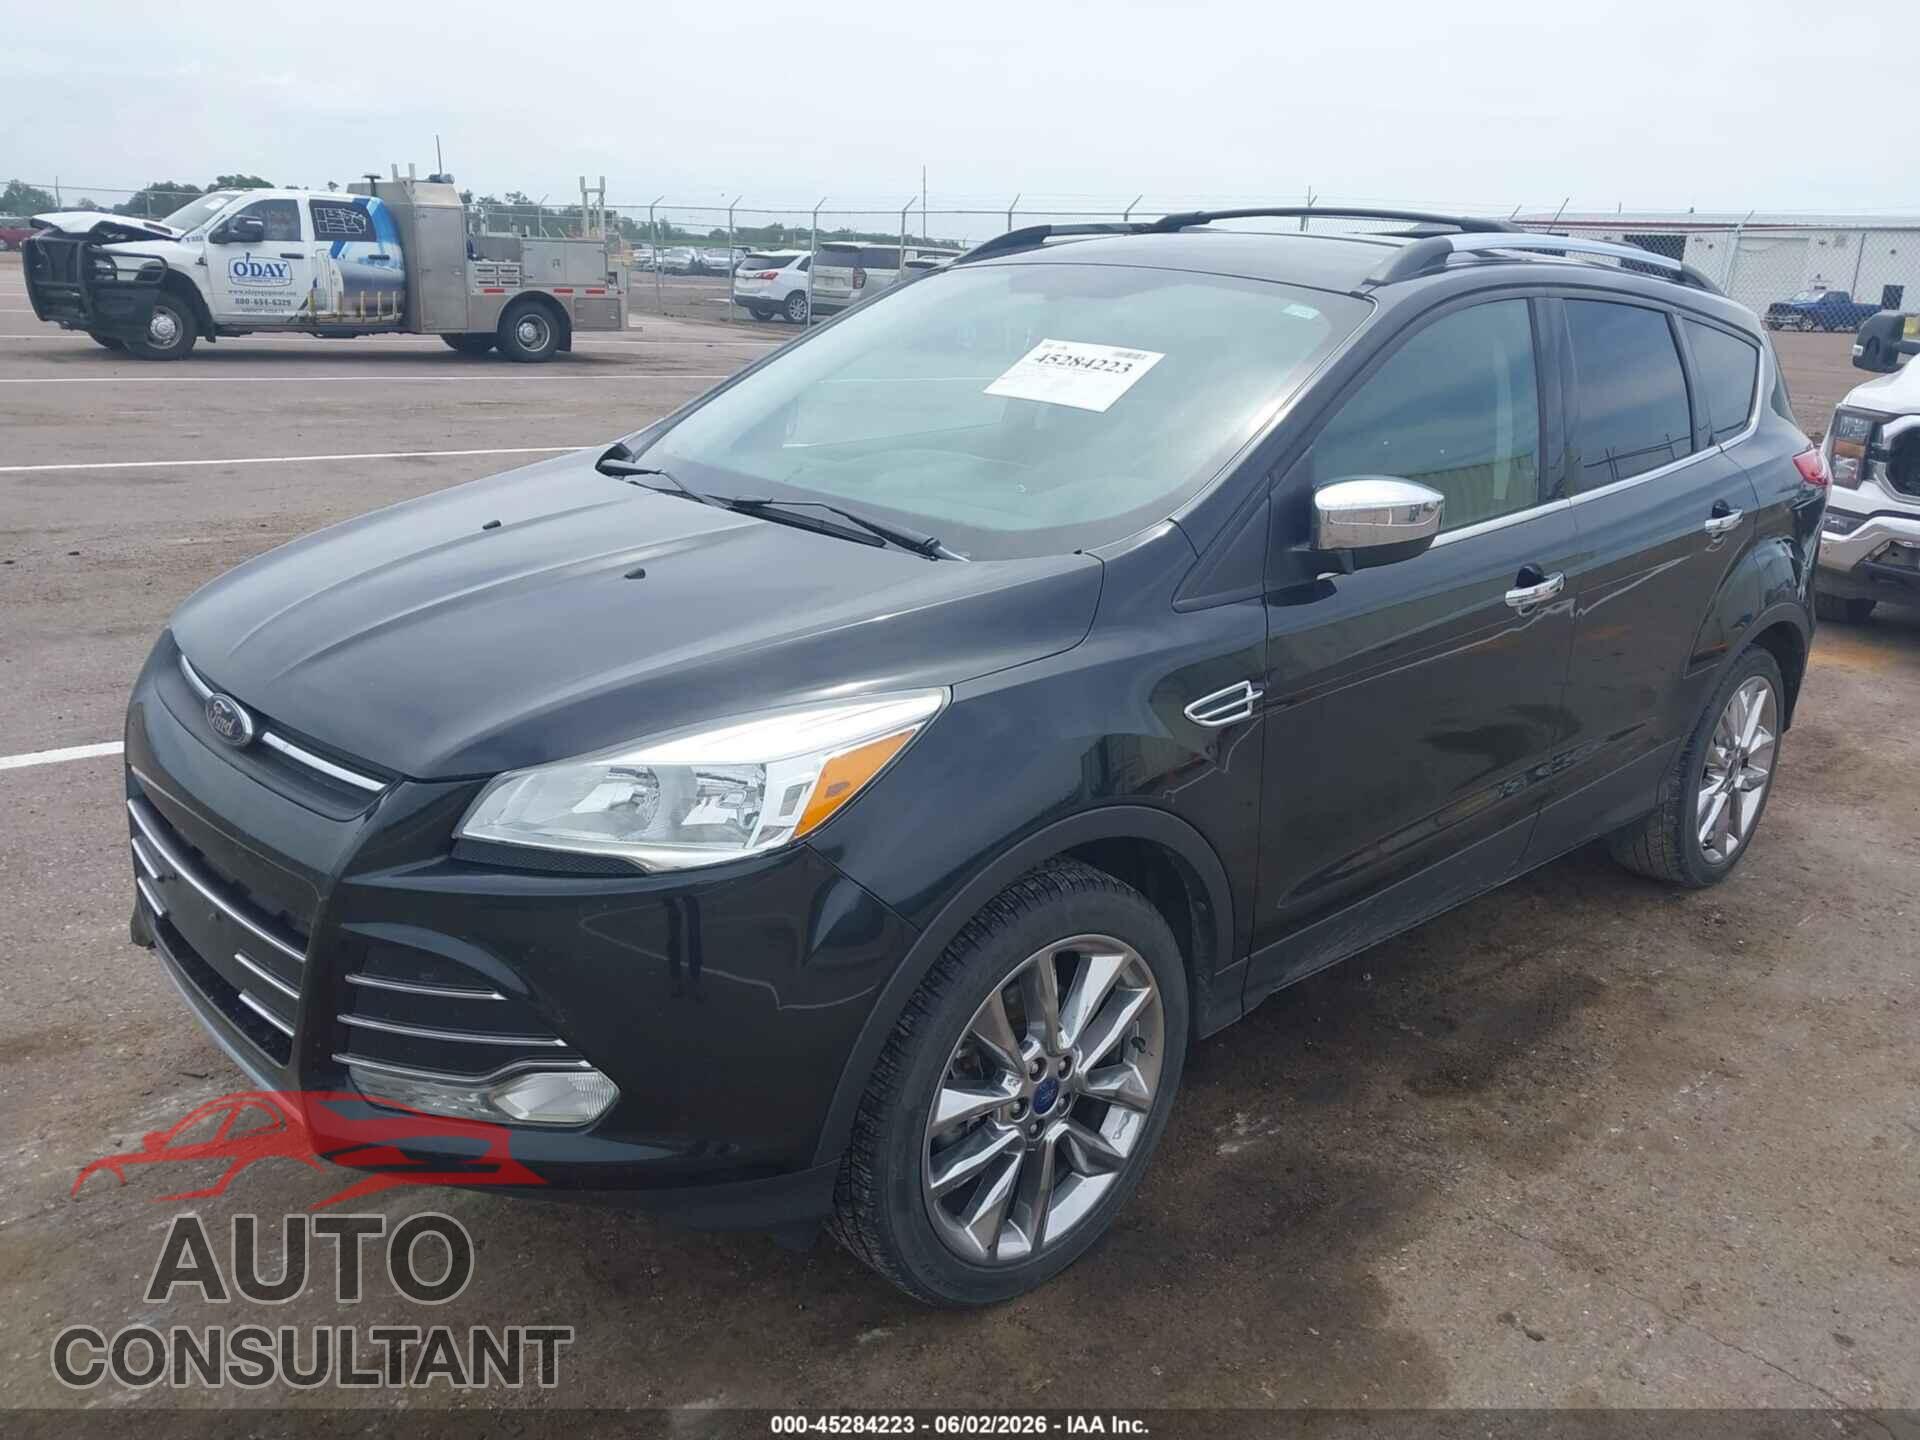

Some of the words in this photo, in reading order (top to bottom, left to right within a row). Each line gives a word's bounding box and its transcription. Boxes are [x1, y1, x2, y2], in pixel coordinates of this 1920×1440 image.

[234, 252, 287, 277] O'DAY
[1034, 353, 1133, 374] 45284223
[209, 699, 234, 737] Ford
